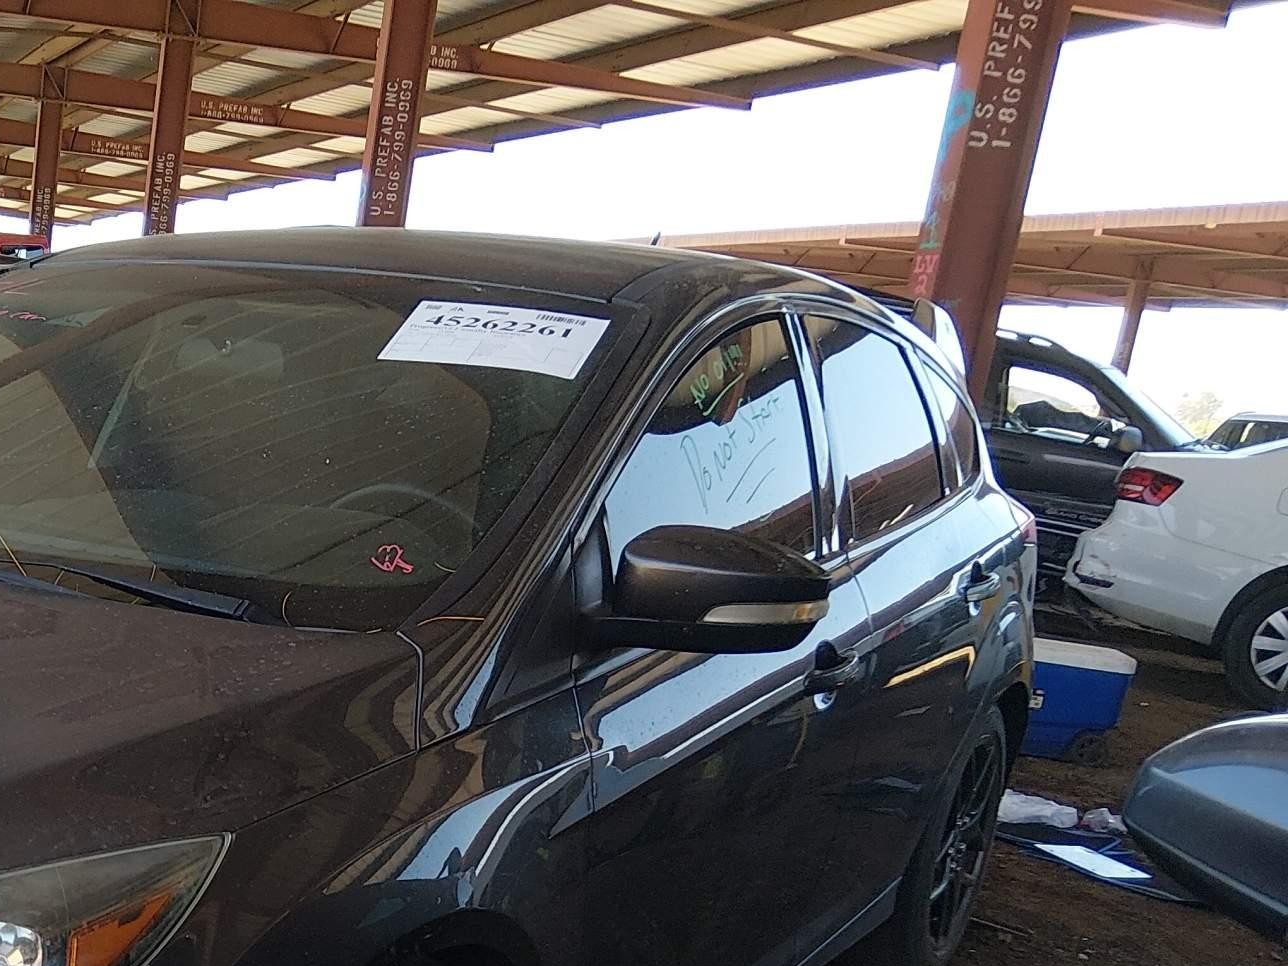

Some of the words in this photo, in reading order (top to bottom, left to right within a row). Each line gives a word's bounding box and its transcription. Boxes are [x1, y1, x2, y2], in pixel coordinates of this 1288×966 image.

[385, 77, 400, 107] INC.
[968, 96, 998, 147] U.S.
[155, 151, 166, 173] INC.
[375, 115, 394, 177] PREFAB
[383, 80, 413, 215] 1-866-799-0969
[151, 178, 163, 220] PREFAB
[370, 186, 385, 216] U.S.
[426, 315, 573, 338] 45262261
